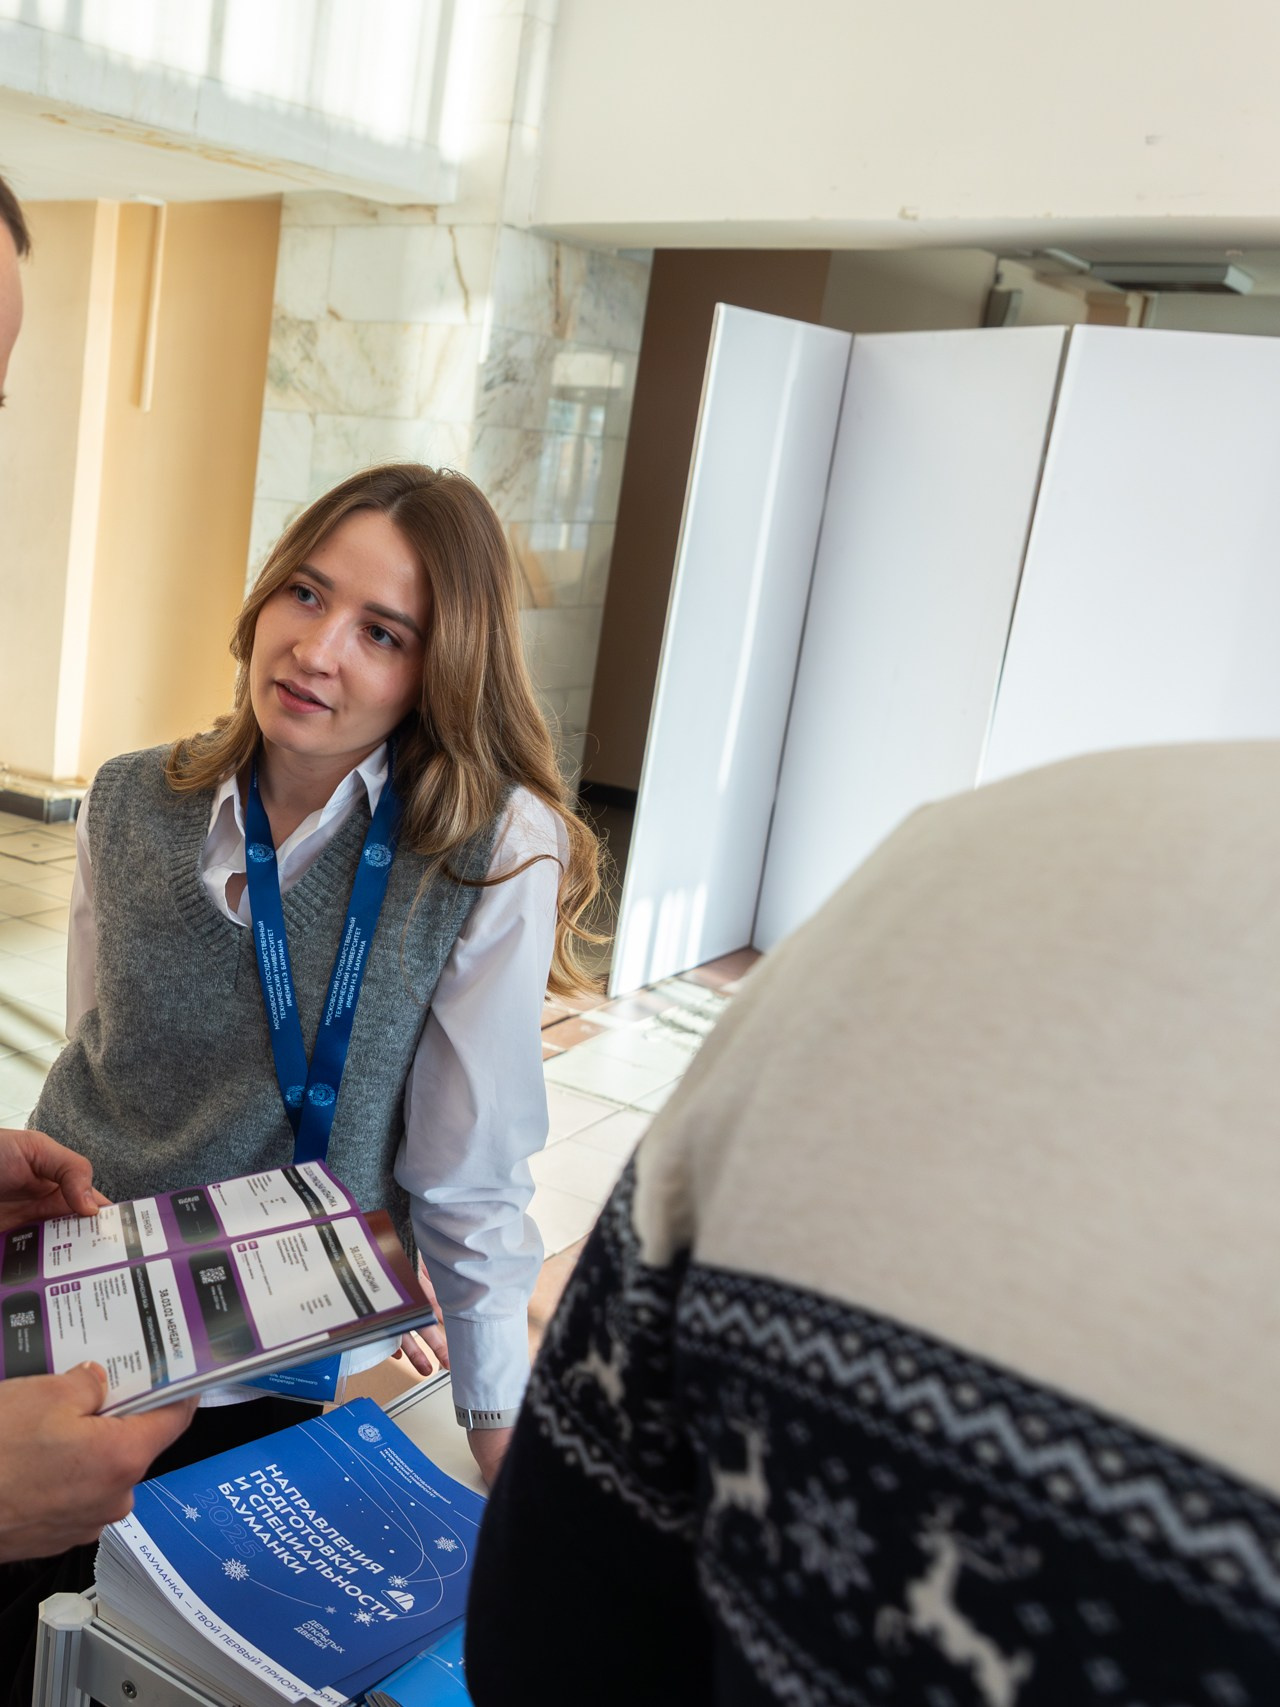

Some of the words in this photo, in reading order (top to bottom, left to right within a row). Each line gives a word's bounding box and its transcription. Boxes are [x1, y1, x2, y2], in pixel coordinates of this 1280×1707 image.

[257, 920, 272, 984] ГОСУДАРСТВЕННЫЙ
[267, 928, 279, 973] УНИВЕРСИТЕТ
[277, 939, 287, 971] БАУМАНА
[325, 980, 340, 1026] МОСКОВСКИЙ
[336, 916, 356, 981] ГОСУДАРСТВЕННЫЙ
[334, 971, 350, 1018] ТЕХНИЧЕСКИЙ
[345, 927, 361, 971] УНИВЕРСИТЕТ
[345, 984, 356, 1008] ИМЕНИ
[355, 940, 366, 971] БАУМАНА
[268, 984, 280, 1030] МОСКОВСКИЙ
[273, 972, 286, 1020] ТЕХНИЧЕСКИЙ
[284, 984, 292, 1007] ИМЕНИ
[158, 1288, 174, 1319] 38.03.02
[193, 1488, 263, 1559] 2025
[218, 1482, 308, 1575] БАУМАНКИ
[234, 1476, 252, 1491] И
[248, 1494, 399, 1622] СПЕЦИАЛЬНОСТИ
[249, 1470, 359, 1575] ПОДГОТОВКИ
[265, 1463, 385, 1575] НАПРАВЛЕНИЯ
[139, 1545, 184, 1599] БАУМАНКА
[194, 1610, 223, 1634] ТВОЙ
[219, 1633, 263, 1666] ПЕРВЫЙ
[307, 1619, 331, 1636] ДЕНЬ
[293, 1626, 328, 1650] ДВЕРЕЙ
[302, 1622, 346, 1654] ОТКРЫТЫХ
